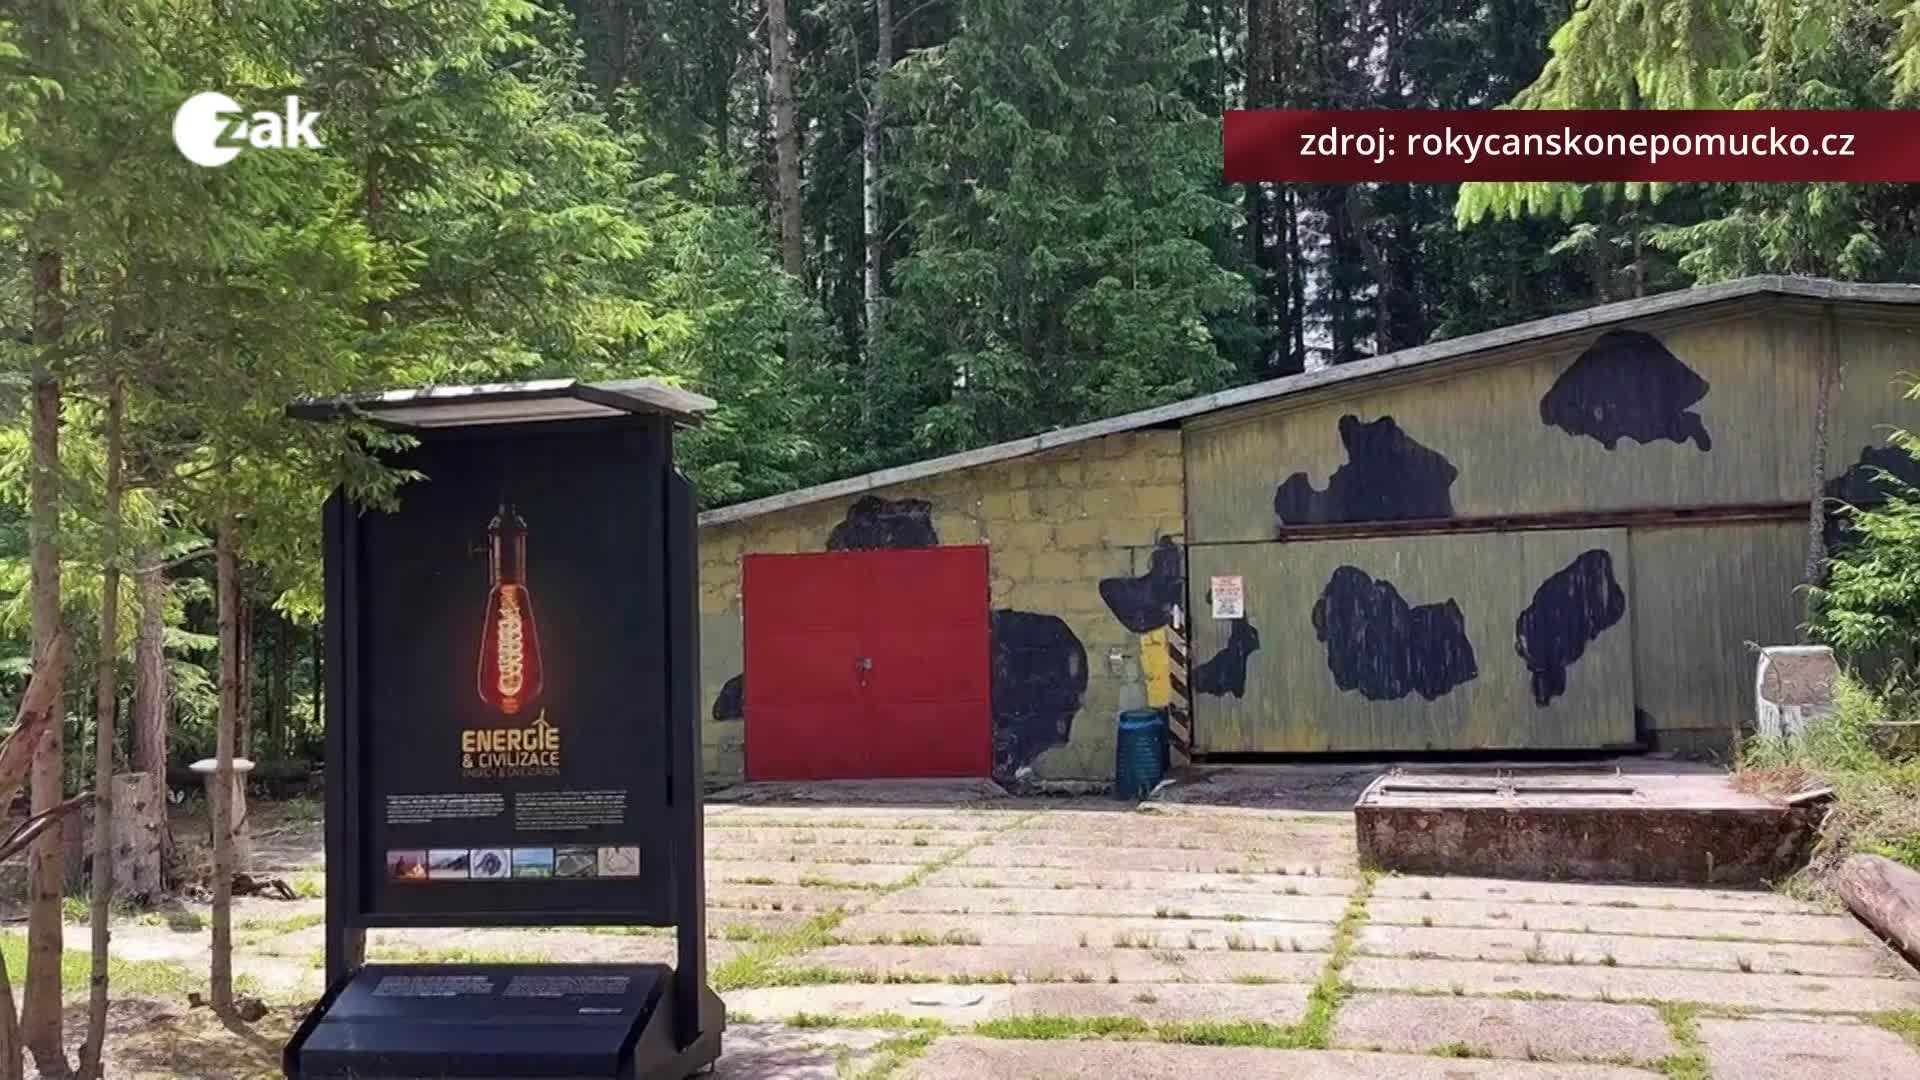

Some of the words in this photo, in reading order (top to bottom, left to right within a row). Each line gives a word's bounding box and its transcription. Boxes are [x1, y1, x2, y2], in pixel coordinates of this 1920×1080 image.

[462, 724, 560, 752] ENERGIE
[462, 753, 474, 768] &
[478, 751, 560, 768] CIVILIZACE
